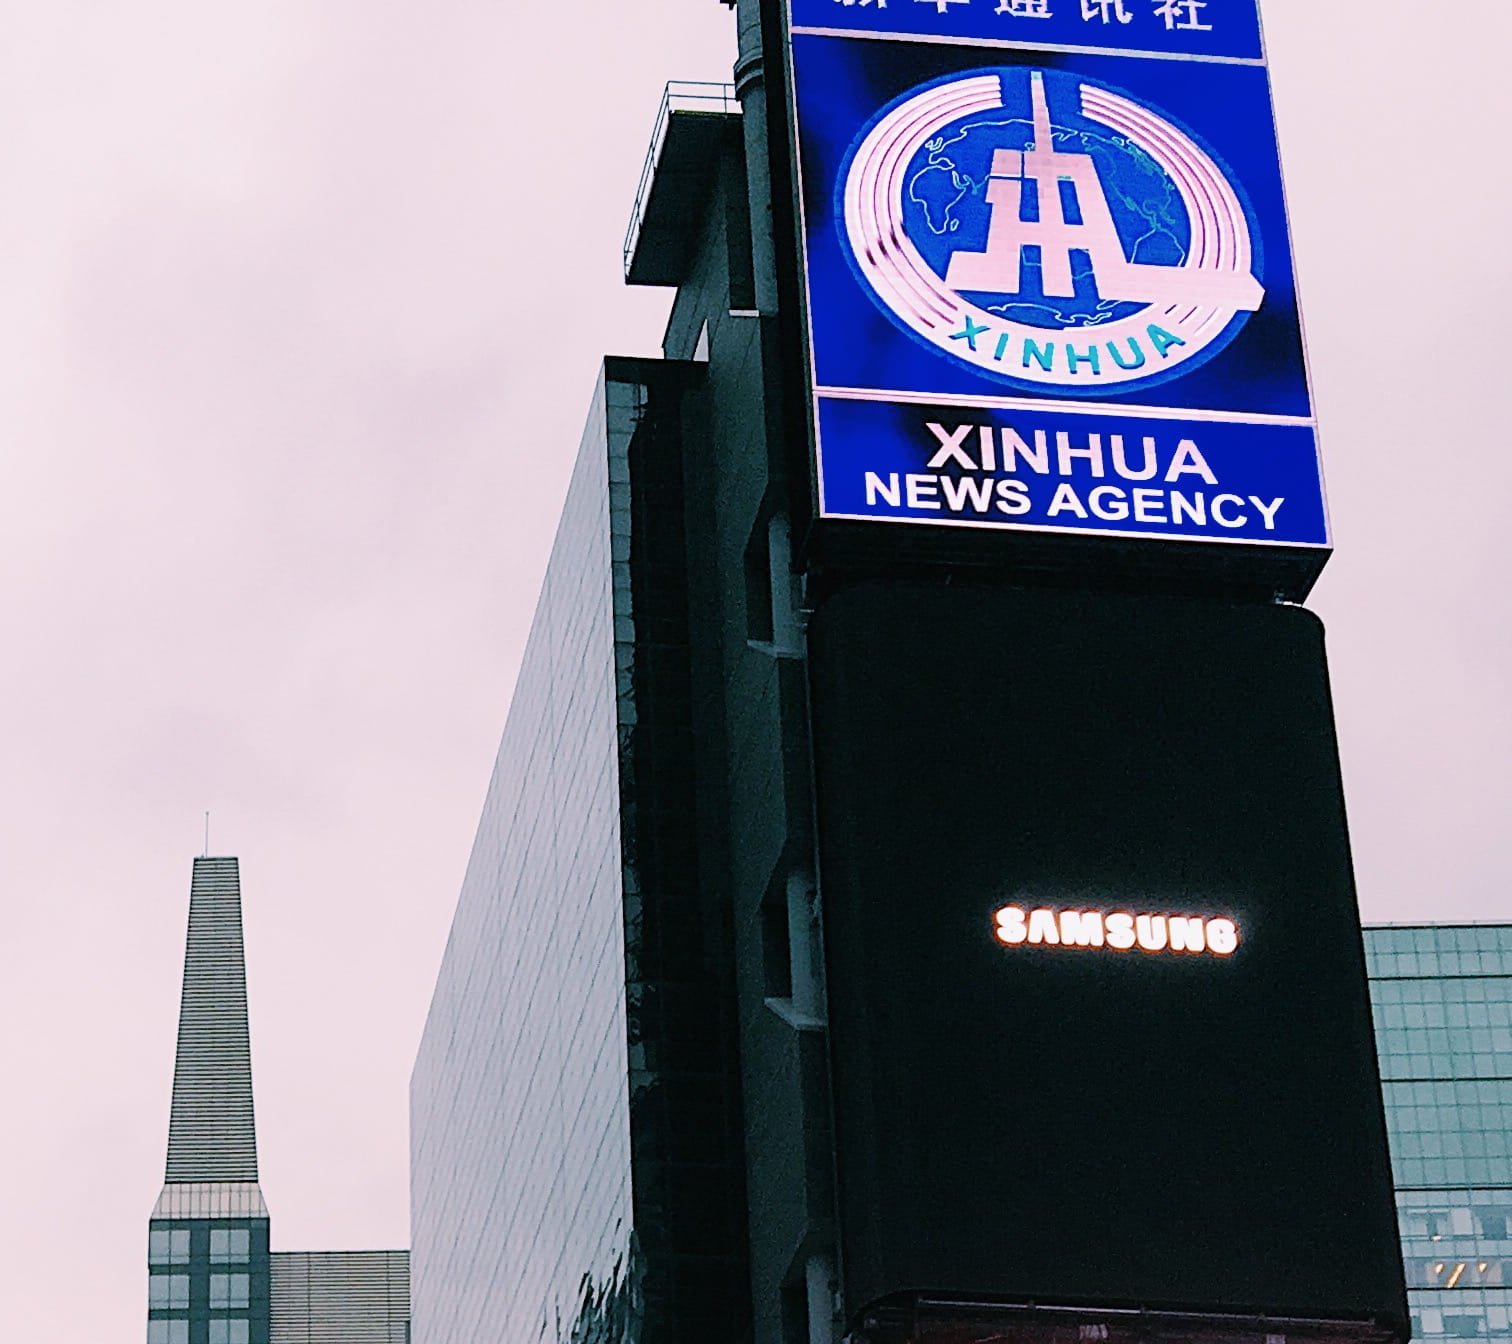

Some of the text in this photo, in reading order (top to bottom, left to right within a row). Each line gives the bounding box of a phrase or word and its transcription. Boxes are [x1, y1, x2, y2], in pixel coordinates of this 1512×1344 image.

[949, 314, 1187, 374] XINHUA
[925, 422, 1218, 484] XINHUA
[865, 471, 1285, 529] NEWS AGENCY
[993, 904, 1239, 956] SAMSUNG
